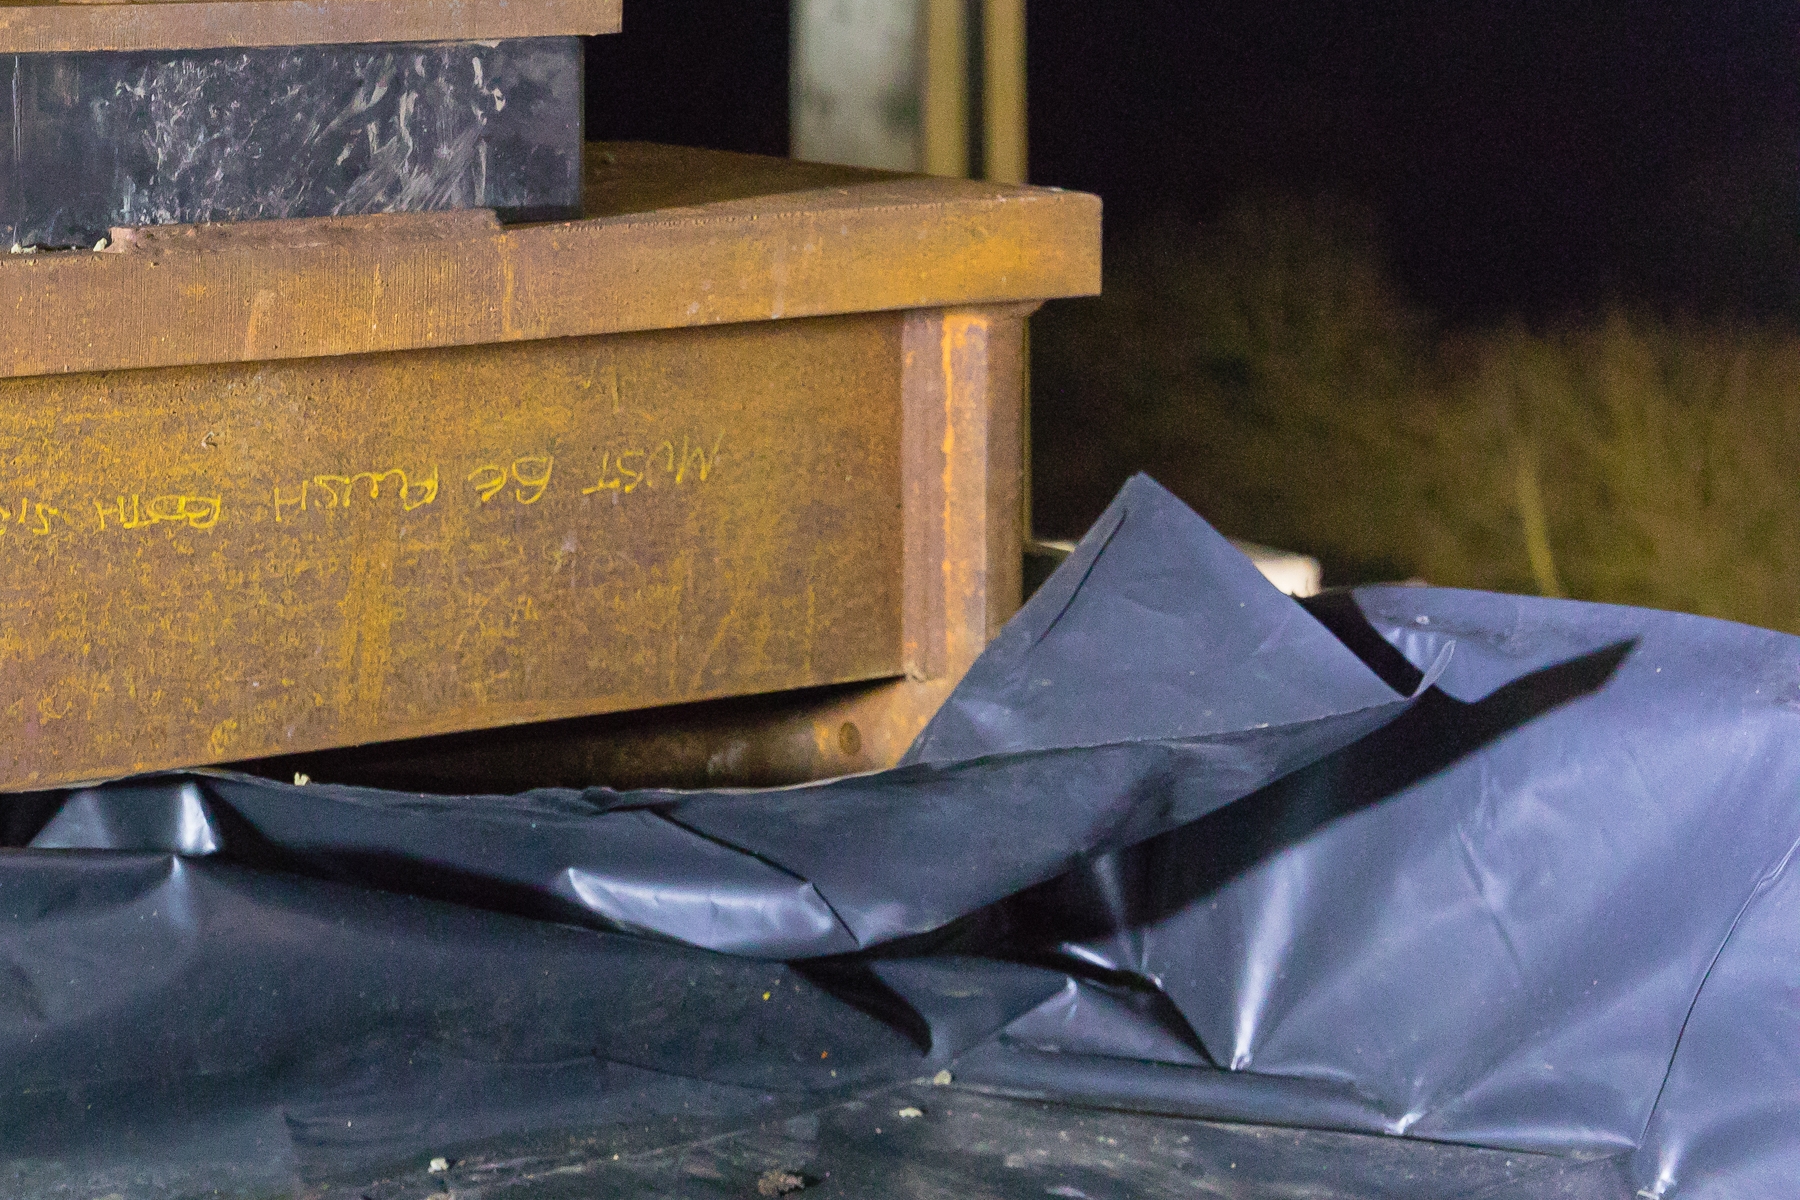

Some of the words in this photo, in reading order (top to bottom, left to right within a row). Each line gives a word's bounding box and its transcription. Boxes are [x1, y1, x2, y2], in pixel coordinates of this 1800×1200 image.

[468, 456, 554, 504] BE
[582, 430, 725, 494] MUST
[96, 494, 222, 529] BOTH
